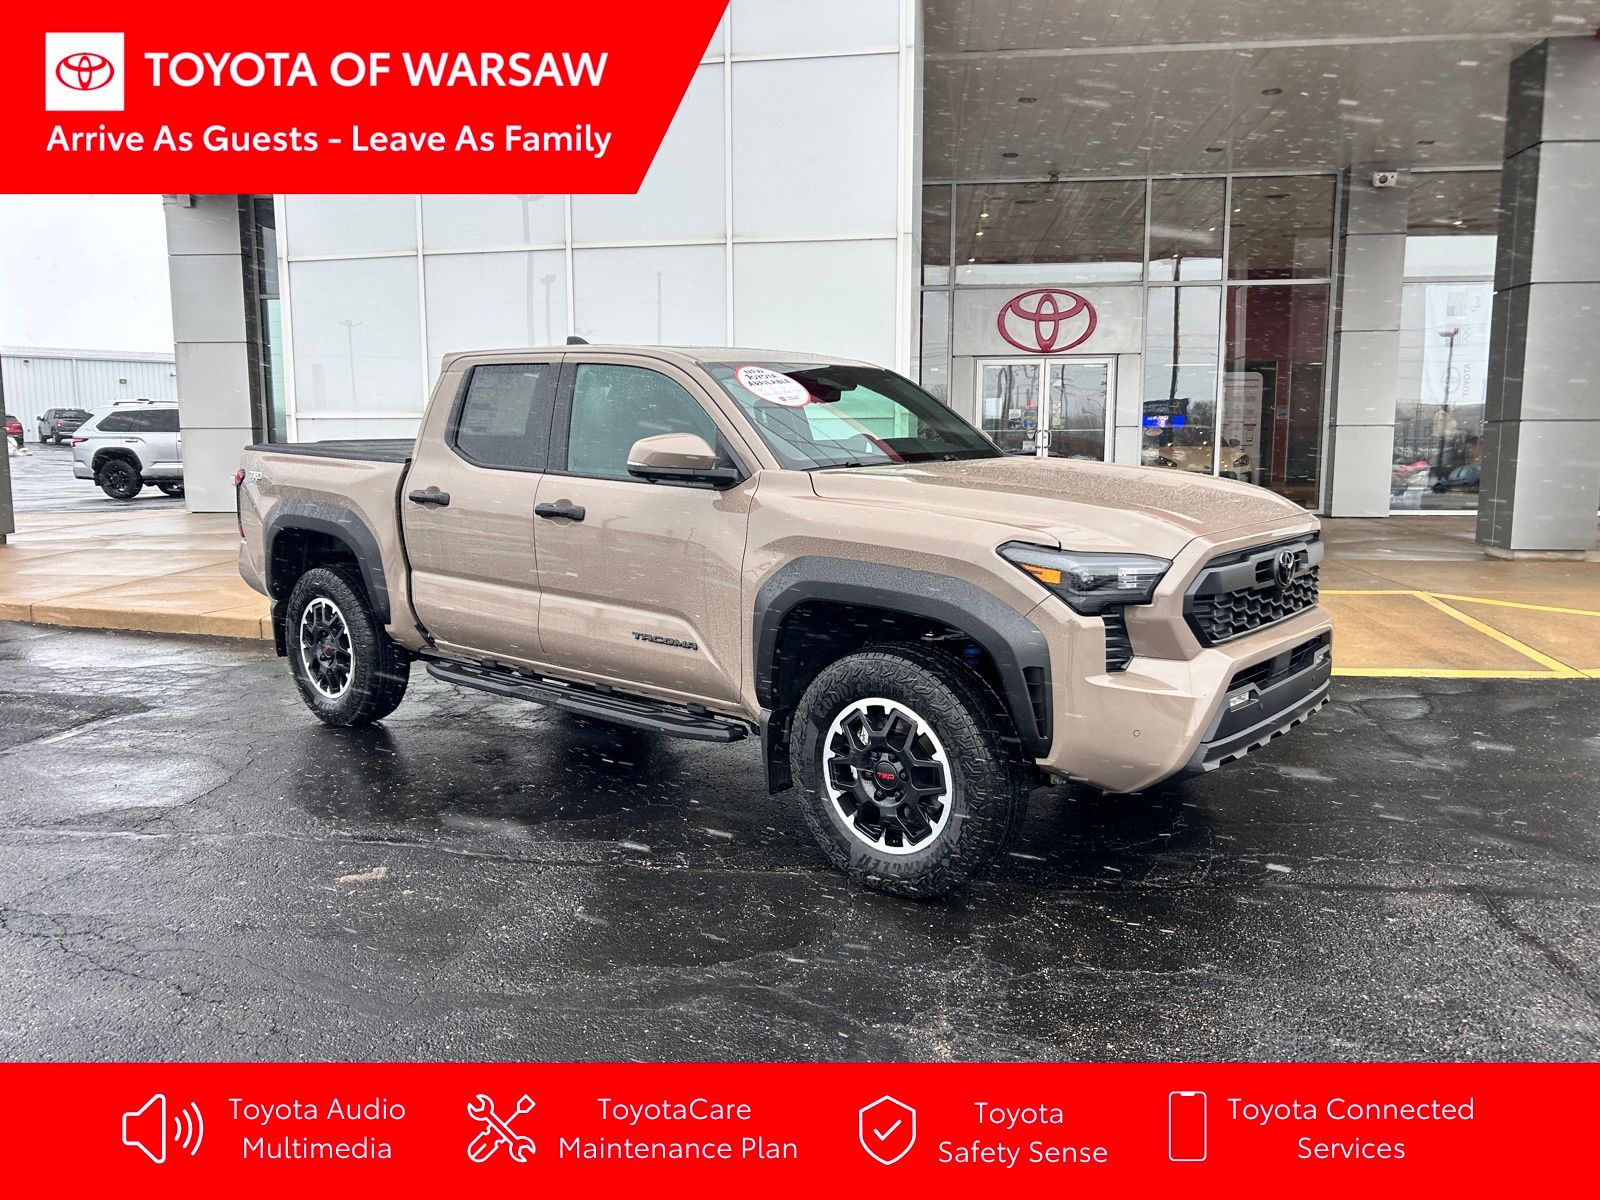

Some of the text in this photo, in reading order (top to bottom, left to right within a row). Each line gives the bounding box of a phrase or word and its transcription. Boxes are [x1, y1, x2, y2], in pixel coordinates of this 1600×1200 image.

[1462, 363, 1471, 397] TOYOTA
[631, 631, 699, 651] TACOMA
[876, 771, 895, 781] TRD
